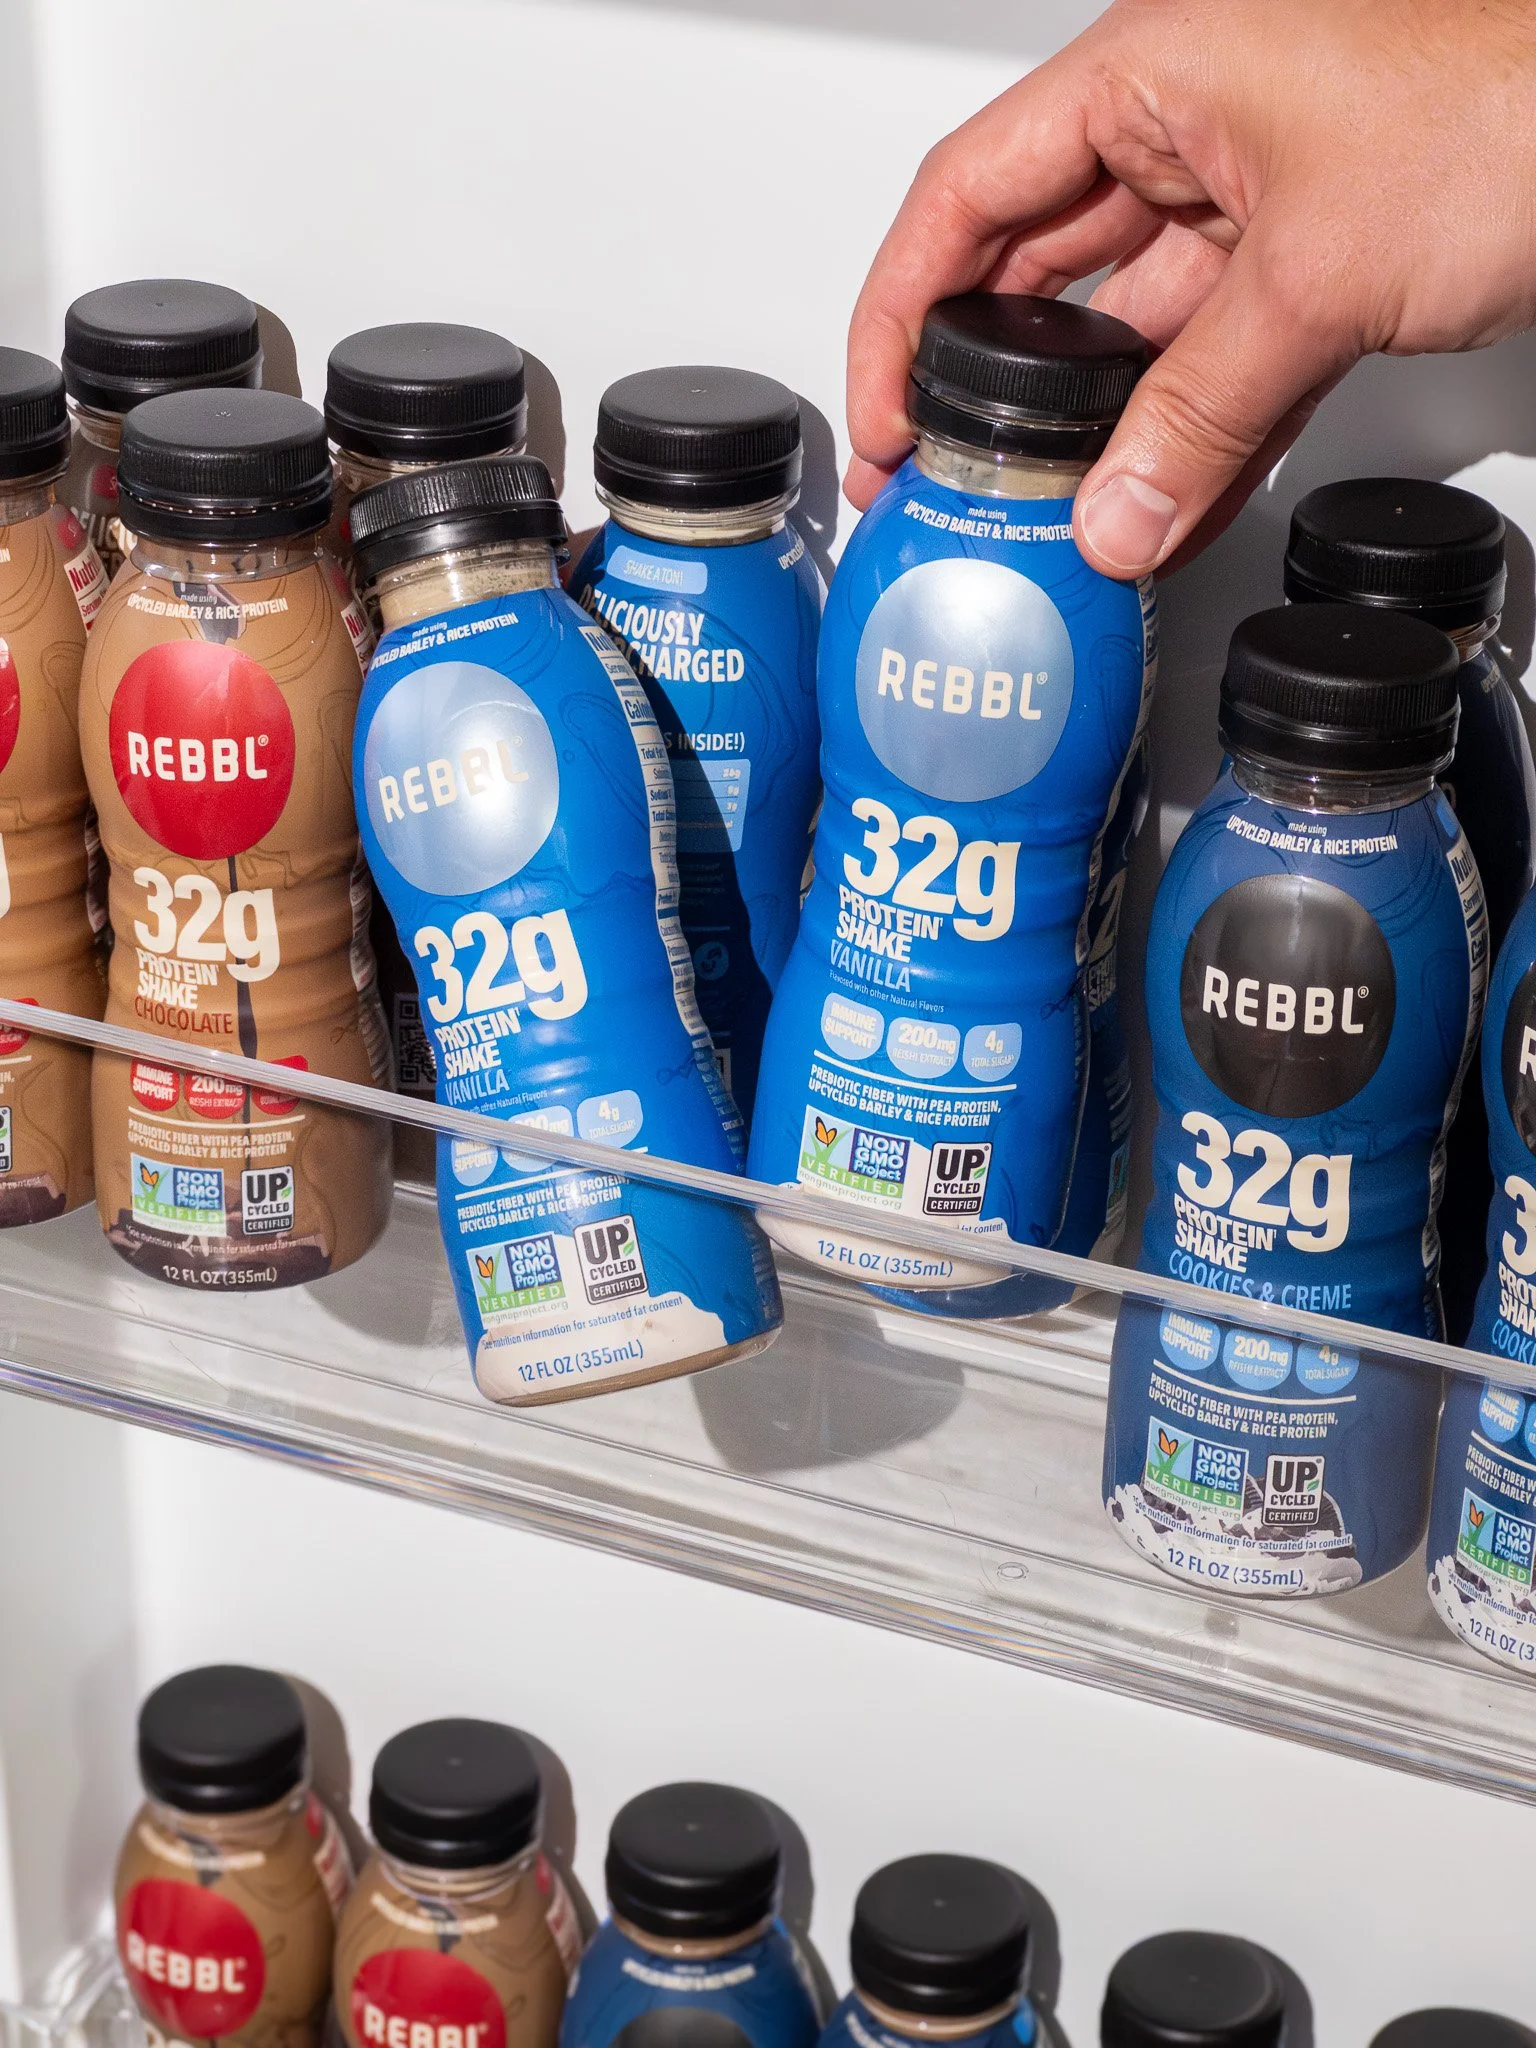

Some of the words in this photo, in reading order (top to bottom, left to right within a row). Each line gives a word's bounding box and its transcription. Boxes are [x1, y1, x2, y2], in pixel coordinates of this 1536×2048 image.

[904, 499, 950, 529] UPCYCLED
[949, 518, 993, 538] BARLEY
[992, 524, 1002, 539] &
[1004, 524, 1032, 541] RICE
[967, 507, 986, 518] made
[988, 510, 1008, 522] using
[624, 560, 652, 579] SHAKE
[1226, 814, 1270, 845] UPCYCLED
[1269, 832, 1312, 853] BARLEY
[1312, 840, 1322, 854] &
[1324, 839, 1350, 855] RICE
[1352, 834, 1398, 854] PROTEIN
[1288, 822, 1308, 833] made
[1308, 825, 1328, 837] using
[844, 797, 1022, 942] 32g
[133, 866, 281, 982] 32g
[836, 910, 913, 963] SHAKE
[414, 908, 588, 1024] 32g
[830, 939, 911, 992] VANILLA
[138, 970, 198, 1009] SHAKE
[829, 969, 854, 990] Flavored
[854, 980, 868, 994] with
[870, 988, 889, 1002] other
[890, 994, 918, 1010] Natural
[919, 1000, 944, 1014] Flavors
[134, 996, 234, 1034] CHOCOLATE
[831, 1002, 876, 1032] IMMUNE
[824, 1018, 878, 1049] SUPPORT
[898, 1022, 957, 1055] 200mg
[984, 1030, 1004, 1054] 4g
[444, 1040, 502, 1080] SHAKE
[445, 1068, 510, 1106] VANILLA
[808, 1078, 857, 1108] UPCYCLED
[859, 1100, 902, 1120] BARLEY
[904, 1110, 914, 1122] &
[915, 1112, 941, 1126] RICE
[943, 1114, 990, 1126] PROTEIN
[810, 1064, 860, 1094] PREBIOTIC
[862, 1084, 894, 1103] FIBER
[896, 1092, 928, 1110] WITH
[930, 1098, 951, 1114] PEA
[954, 1100, 1002, 1114] PROTEIN,
[854, 1148, 904, 1169] GMO
[858, 1132, 906, 1155] NON
[176, 1170, 218, 1186] NON
[805, 1156, 899, 1194] VERIFIED
[854, 1159, 902, 1182] Project
[1178, 1111, 1352, 1253] 32g
[176, 1184, 220, 1198] GMO
[176, 1196, 220, 1210] Project
[934, 1182, 980, 1194] CYCLED
[135, 1197, 222, 1223] VERIFIED
[247, 1202, 290, 1216] CYCLED
[930, 1200, 978, 1210] CERTIFIED
[247, 1219, 290, 1230] CERTIFIED
[508, 1238, 552, 1260] NON
[818, 1240, 835, 1258] 12
[839, 1248, 856, 1266] FL
[858, 1252, 881, 1270] OZ
[884, 1256, 954, 1278] (355mL)
[1175, 1219, 1248, 1273] SHAKE
[163, 1265, 180, 1280] 12
[183, 1269, 198, 1282] FL
[200, 1271, 223, 1284] OZ
[223, 1268, 278, 1286] (355mL)
[512, 1254, 556, 1276] GMO
[515, 1270, 558, 1288] Project
[590, 1259, 636, 1281] CYCLED
[1169, 1250, 1255, 1298] COOKIES
[1258, 1282, 1274, 1301] &
[1282, 1284, 1352, 1310] CREME
[481, 1286, 562, 1311] VERIFIED
[593, 1277, 641, 1298] CERTIFIED
[1498, 1260, 1536, 1306] PROT
[493, 1333, 522, 1348] nutrition
[522, 1324, 572, 1342] information
[574, 1320, 586, 1330] for
[588, 1307, 632, 1327] saturated
[634, 1303, 648, 1317] fat
[648, 1296, 684, 1313] content
[1168, 1312, 1213, 1344] IMMUNE
[1500, 1288, 1536, 1336] SHAK
[1162, 1328, 1214, 1361] SUPPORT
[1234, 1335, 1288, 1366] 200mg
[1320, 1345, 1339, 1366] 4g
[1492, 1318, 1536, 1366] COOKI
[518, 1364, 536, 1382] 12
[536, 1360, 554, 1378] FL
[554, 1356, 572, 1375] OZ
[575, 1338, 644, 1374] (355mL)
[1148, 1386, 1194, 1418] UPCYCLED
[1197, 1410, 1238, 1431] BARLEY
[1240, 1421, 1250, 1433] &
[1251, 1424, 1277, 1438] RICE
[1280, 1425, 1328, 1439] PROTEIN
[1150, 1372, 1198, 1406] PREBIOTIC
[1200, 1396, 1230, 1416] FIBER
[1233, 1406, 1263, 1422] WITH
[1265, 1412, 1286, 1425] PEA
[1289, 1412, 1338, 1426] PROTEIN,
[1482, 1398, 1518, 1432] SUPPORT
[1196, 1458, 1240, 1481] GMO
[1198, 1443, 1241, 1466] NON
[1467, 1444, 1502, 1478] PREBIOTIC
[1502, 1466, 1526, 1489] FIBER
[1151, 1466, 1238, 1508] VERIFIED
[1194, 1473, 1240, 1492] Project
[1466, 1457, 1500, 1490] UPCYCLED
[1500, 1480, 1532, 1505] BARLEY
[1268, 1511, 1314, 1522] CERTIFIED
[1270, 1494, 1316, 1506] CYCLED
[1147, 1507, 1182, 1530] nutrition
[1183, 1522, 1240, 1546] information
[1242, 1538, 1256, 1549] for
[1258, 1539, 1303, 1551] saturated
[1305, 1540, 1318, 1551] fat
[1318, 1536, 1351, 1549] content
[1496, 1531, 1532, 1555] GMO
[1498, 1516, 1533, 1542] NON
[1167, 1548, 1184, 1568] 12
[1188, 1556, 1205, 1574] FL
[1208, 1561, 1230, 1580] OZ
[1233, 1566, 1304, 1586] (355mL)
[1462, 1538, 1528, 1582] VERIFIED
[1494, 1544, 1530, 1566] Project
[1470, 1618, 1481, 1638] 12
[1484, 1626, 1497, 1647] FL
[1500, 1634, 1516, 1654] OZ
